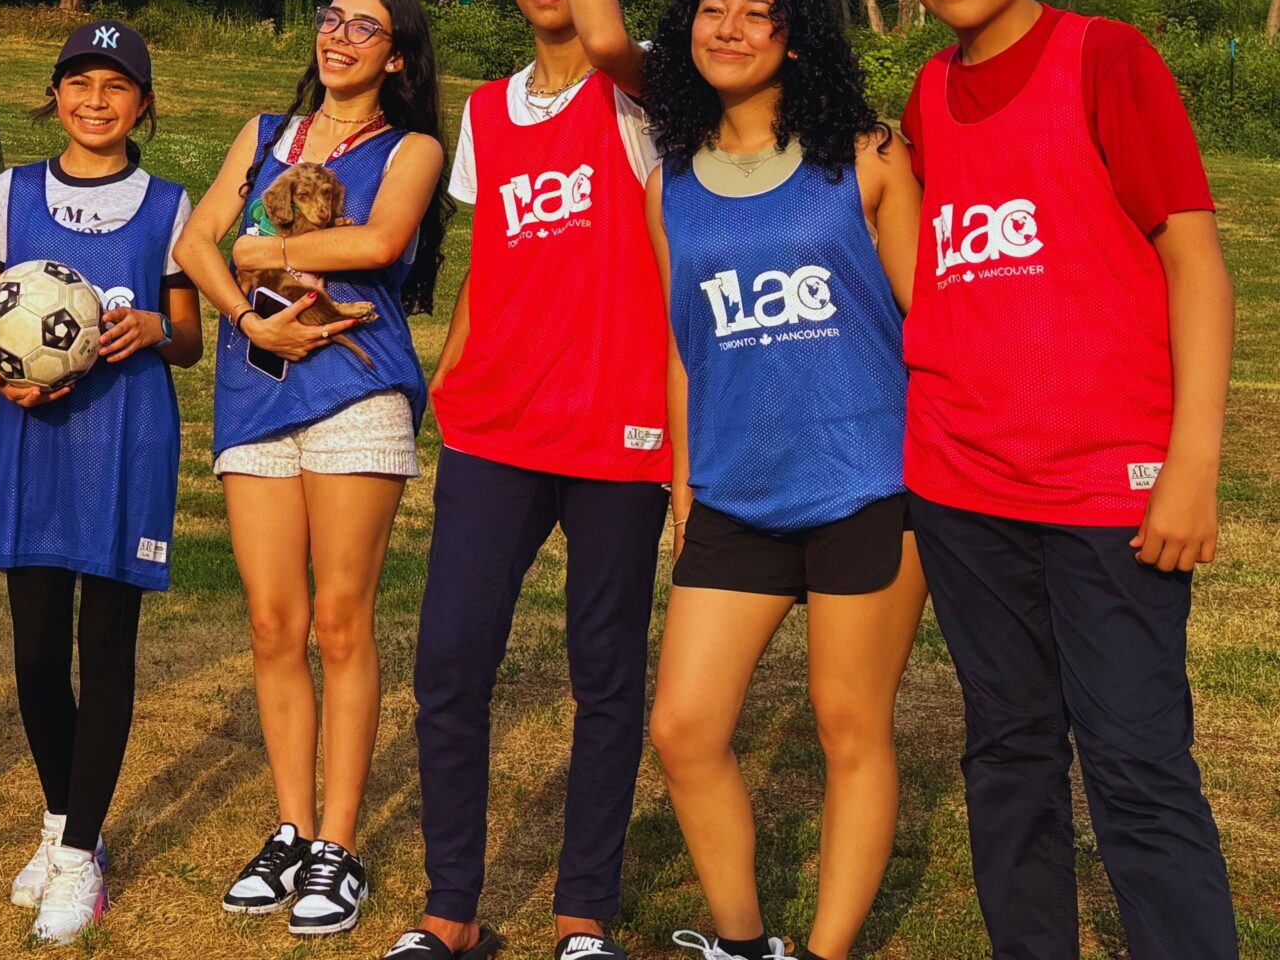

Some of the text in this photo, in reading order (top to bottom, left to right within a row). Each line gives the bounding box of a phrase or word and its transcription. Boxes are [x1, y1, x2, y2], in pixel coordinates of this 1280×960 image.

[92, 25, 120, 48] NY
[978, 265, 1044, 280] VANCOUVER
[719, 328, 840, 351] TORONTO VANCOUVER
[1132, 465, 1151, 478] ATC
[567, 936, 604, 952] NIKE
